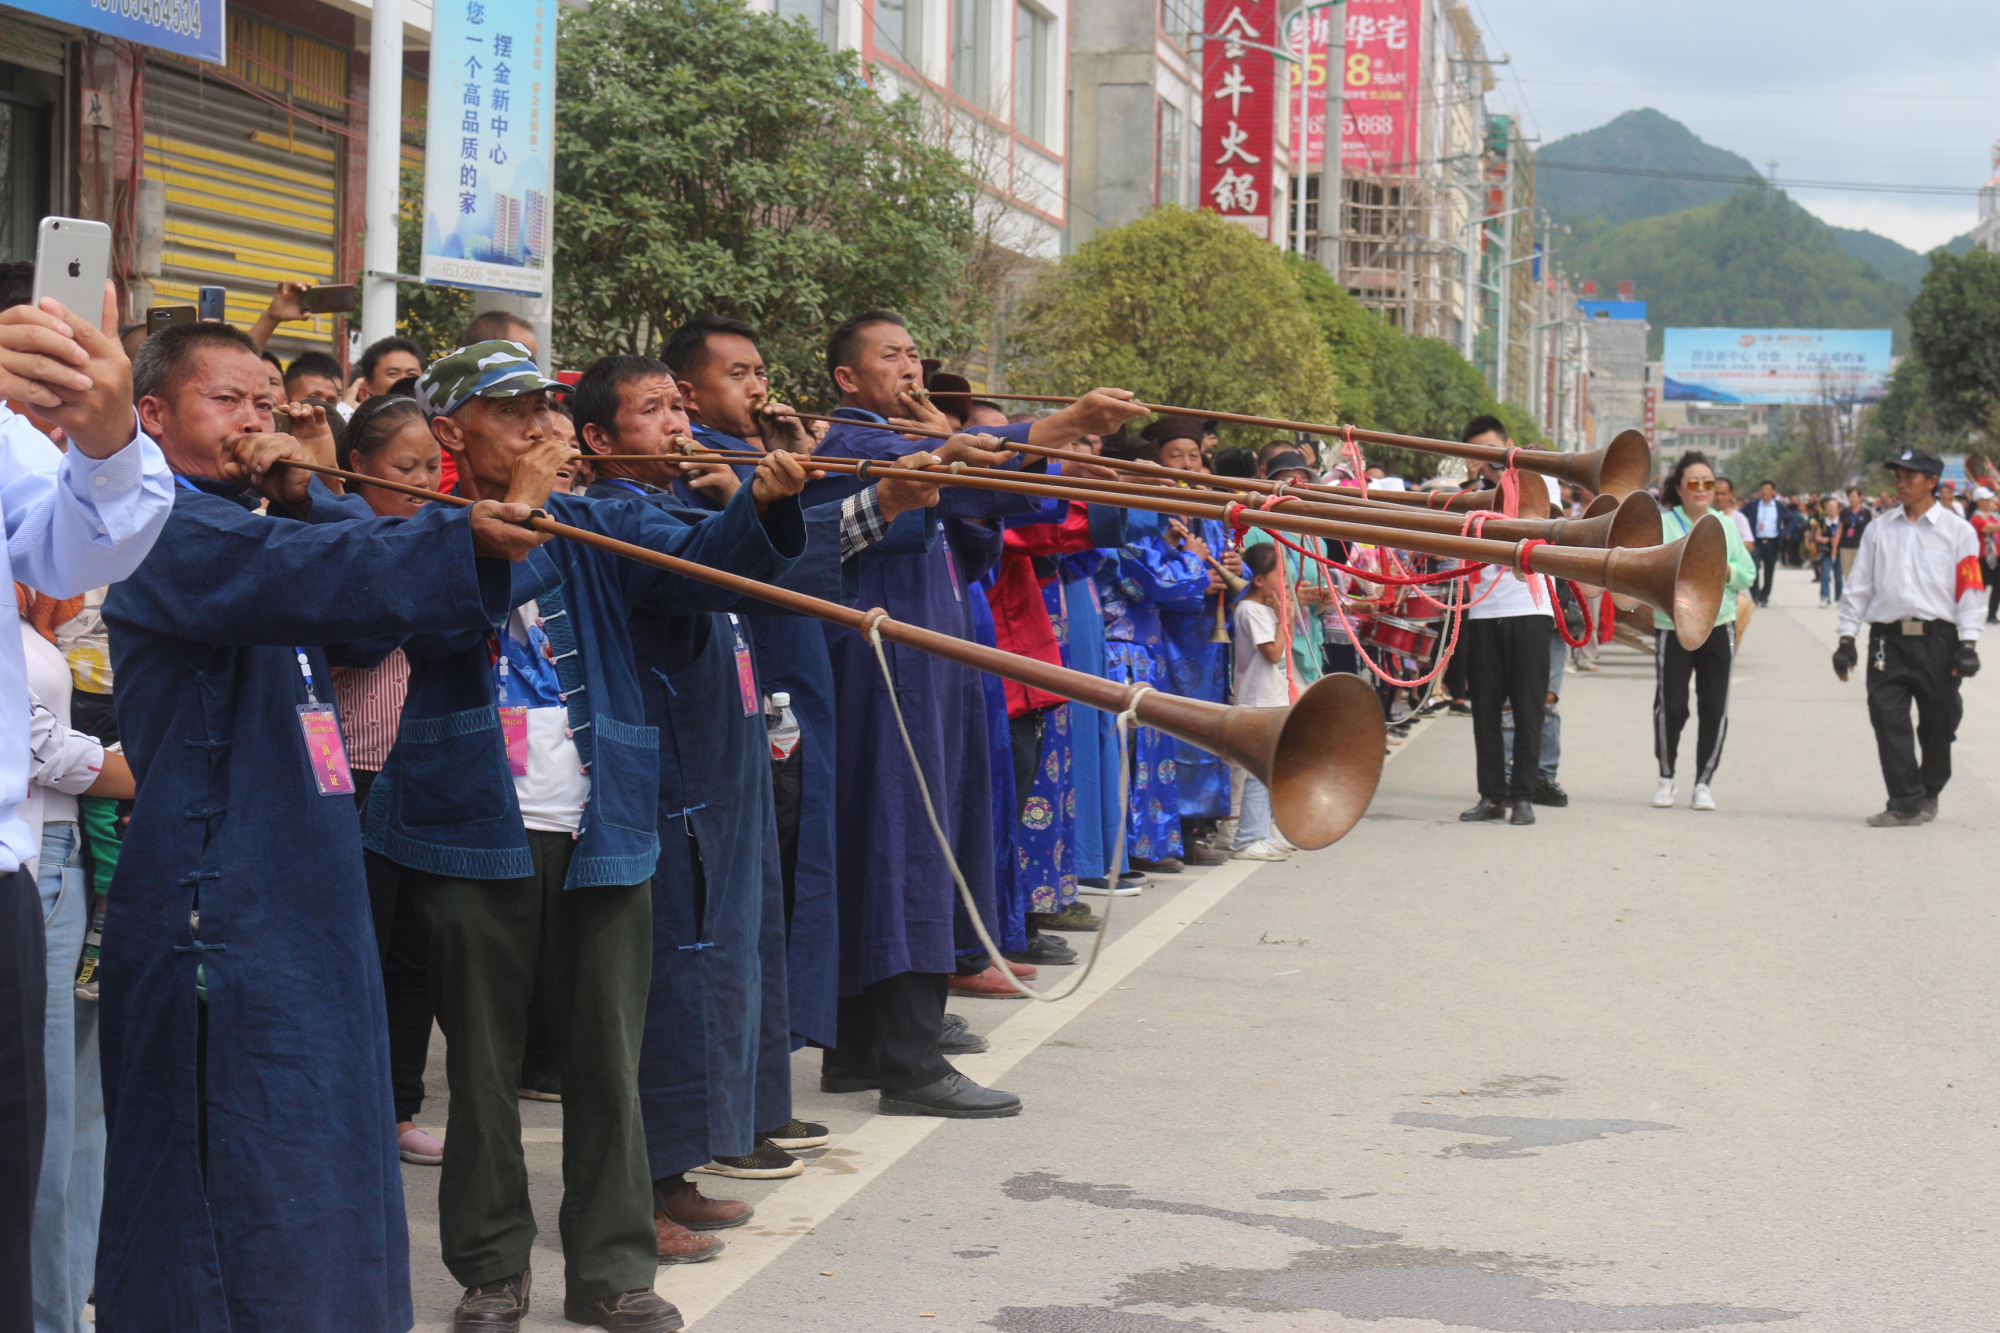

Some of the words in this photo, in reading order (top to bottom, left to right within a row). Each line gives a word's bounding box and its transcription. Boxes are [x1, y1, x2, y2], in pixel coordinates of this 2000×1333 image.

[92, 0, 201, 39] 5464534
[459, 0, 485, 214] 您一个高品质的家
[488, 32, 513, 165] 摆金新中心
